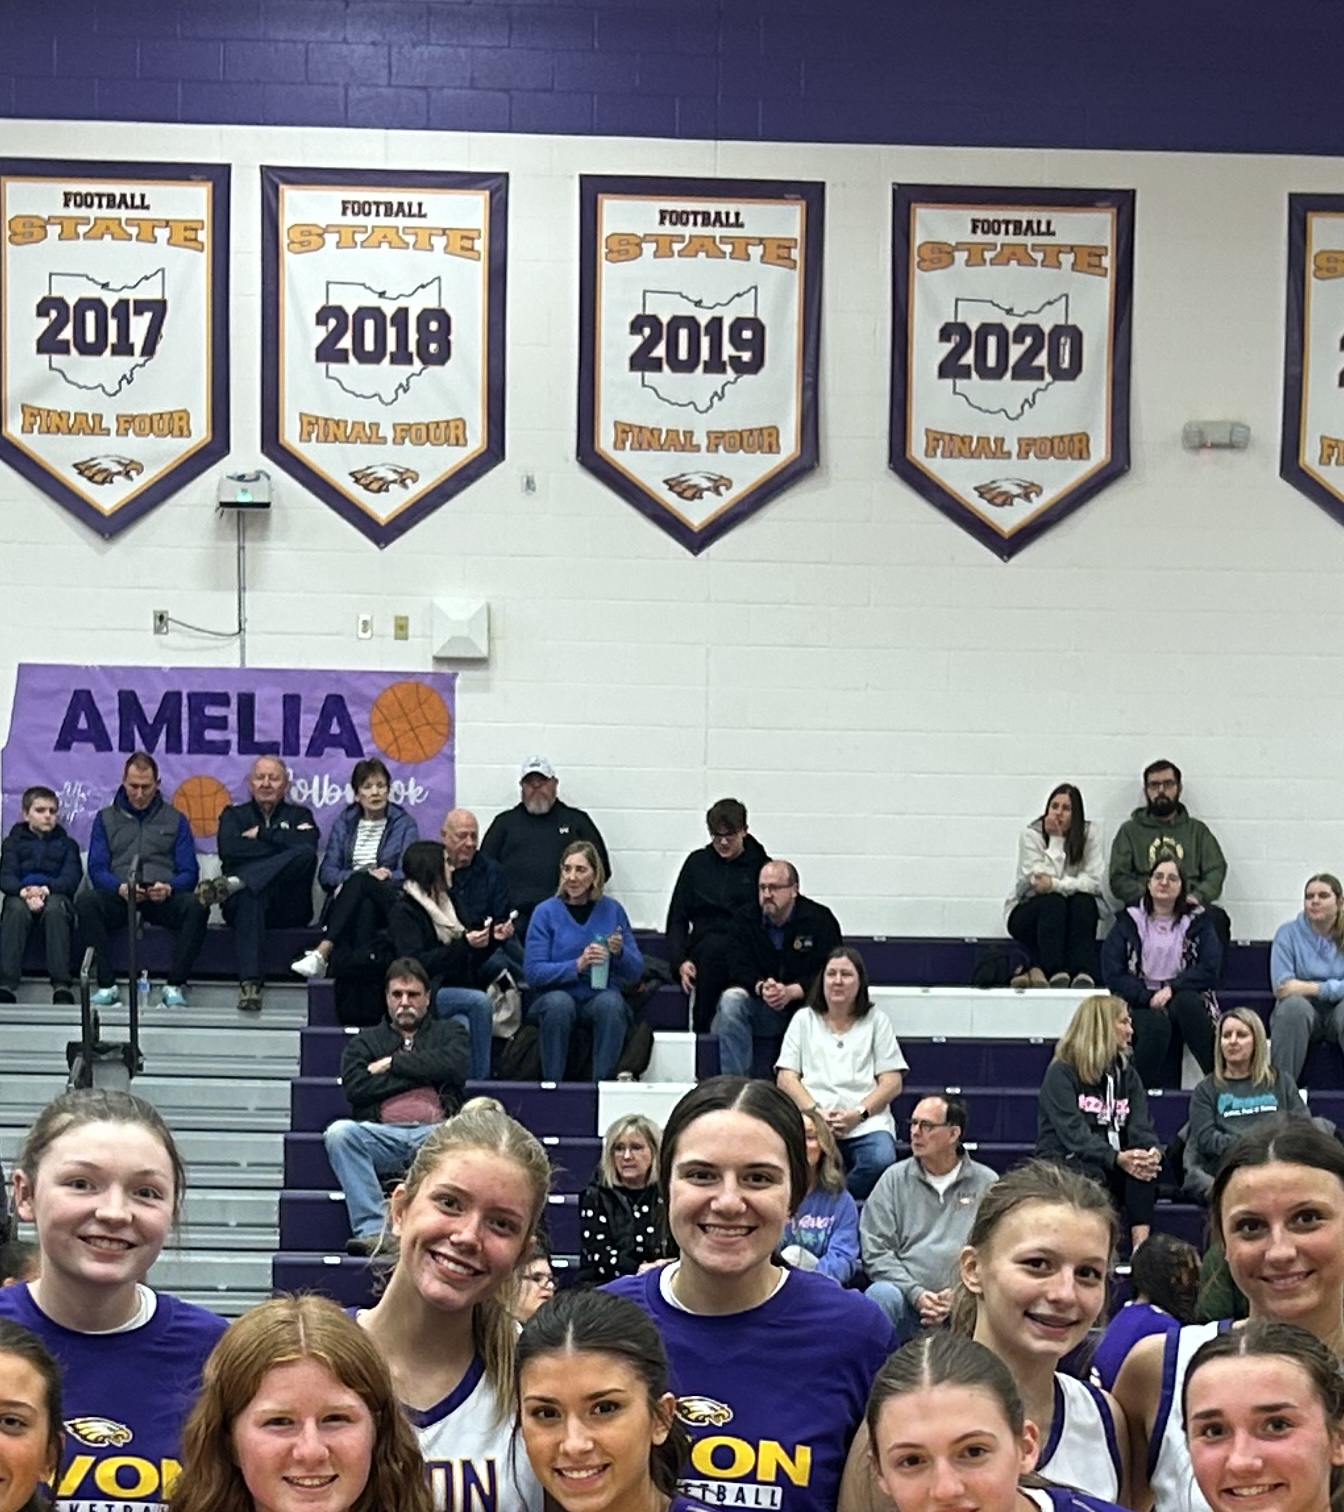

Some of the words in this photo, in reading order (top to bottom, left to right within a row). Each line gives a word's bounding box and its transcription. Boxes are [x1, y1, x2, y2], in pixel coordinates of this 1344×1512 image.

[63, 192, 150, 210] FOOTBALL
[341, 200, 427, 218] FOOTBALL
[659, 209, 744, 228] FOOTBALL
[8, 215, 205, 252] STATE
[287, 223, 481, 261] STATE
[971, 218, 1055, 237] FOOTBALL
[604, 232, 798, 269] STATE
[916, 241, 1108, 277] STATE
[36, 296, 167, 357] 2017
[315, 305, 452, 366] 2018
[629, 314, 765, 374] 2019
[938, 322, 1083, 381] 2020
[21, 403, 110, 435] FINAL
[116, 409, 191, 438] FOUR
[299, 413, 386, 444] FINAL
[392, 418, 467, 447] FOUR
[613, 420, 700, 452] FINAL
[706, 425, 780, 454] FOUR
[924, 429, 1011, 460] FINAL
[1017, 432, 1090, 461] FOUR
[54, 689, 365, 758] AMELIA
[691, 1435, 812, 1487] ON
